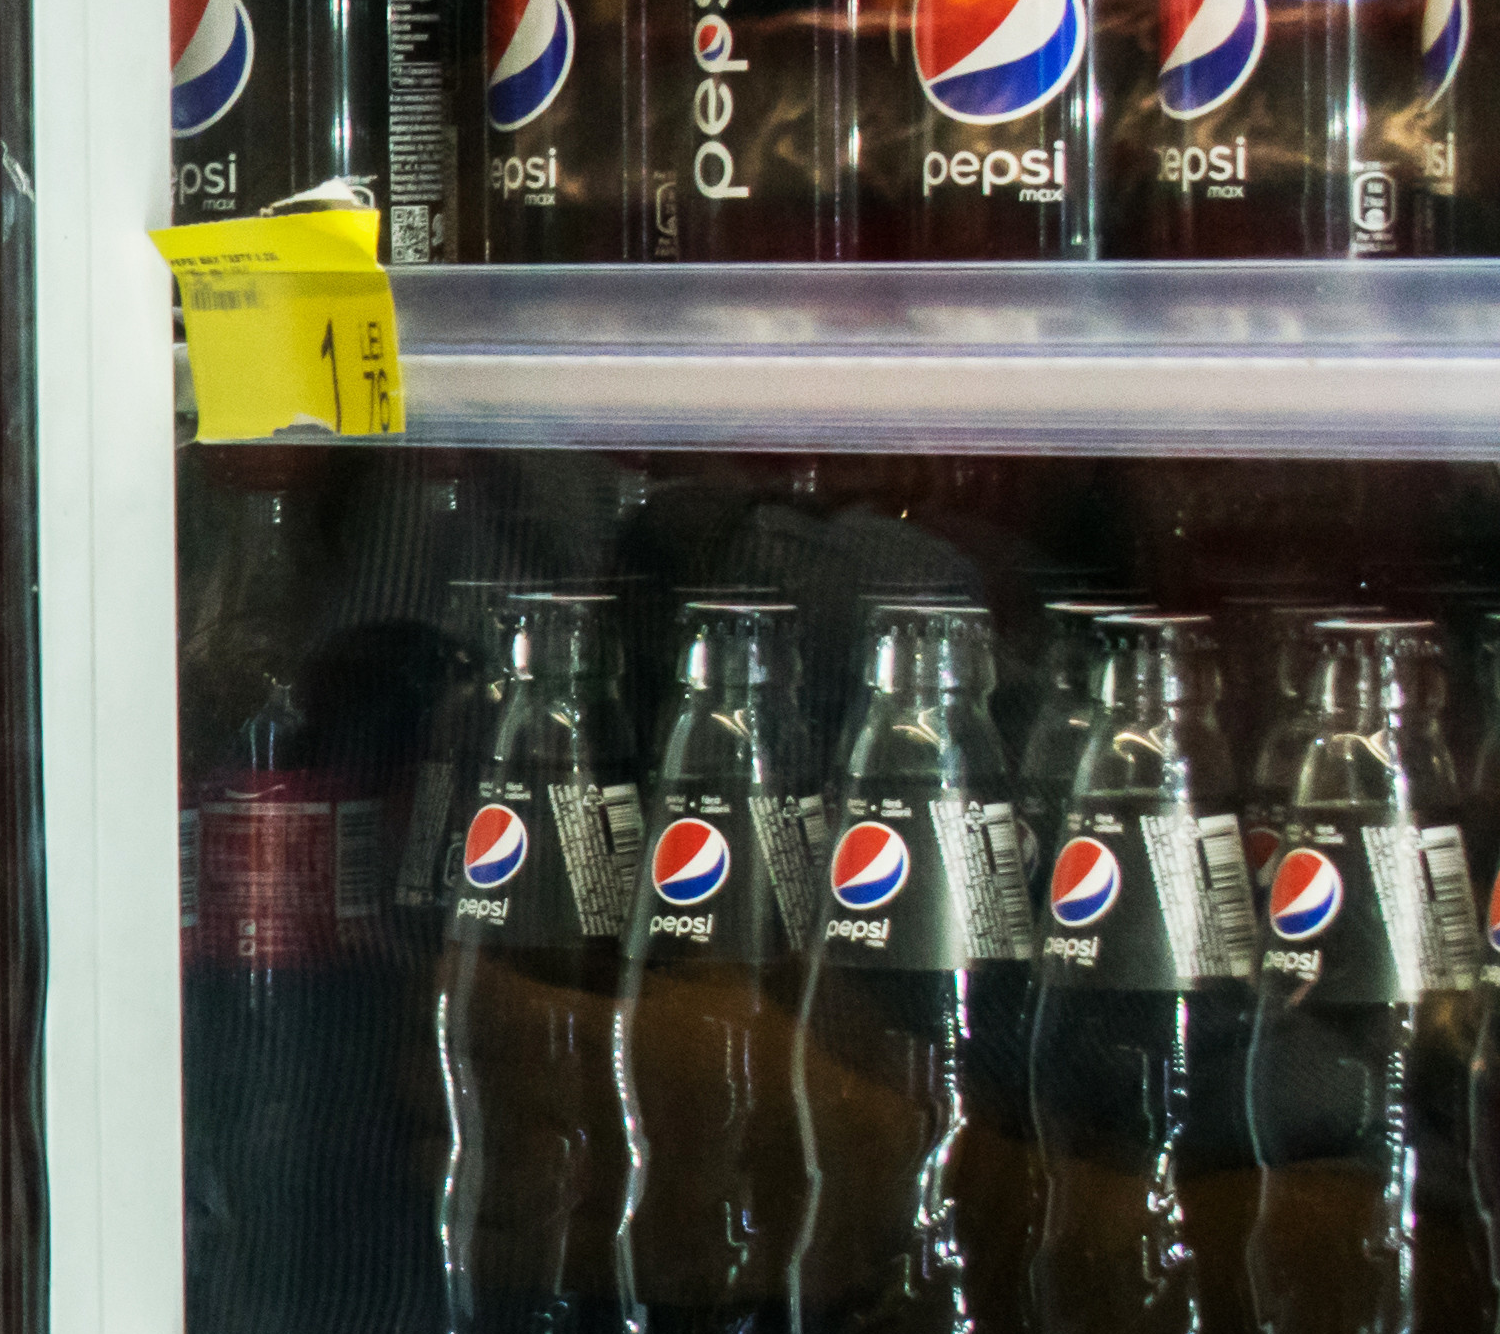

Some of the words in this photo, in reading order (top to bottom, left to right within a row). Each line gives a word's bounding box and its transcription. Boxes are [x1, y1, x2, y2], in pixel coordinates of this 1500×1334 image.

[922, 139, 1066, 197] pepsi
[523, 192, 557, 207] max
[1018, 186, 1065, 203] max
[1206, 182, 1245, 198] max
[320, 317, 342, 433] 1
[361, 320, 384, 361] LEI
[362, 368, 390, 433] 76
[456, 898, 508, 919] pepsi
[649, 913, 714, 936] pepsi
[825, 918, 891, 942] pepsi
